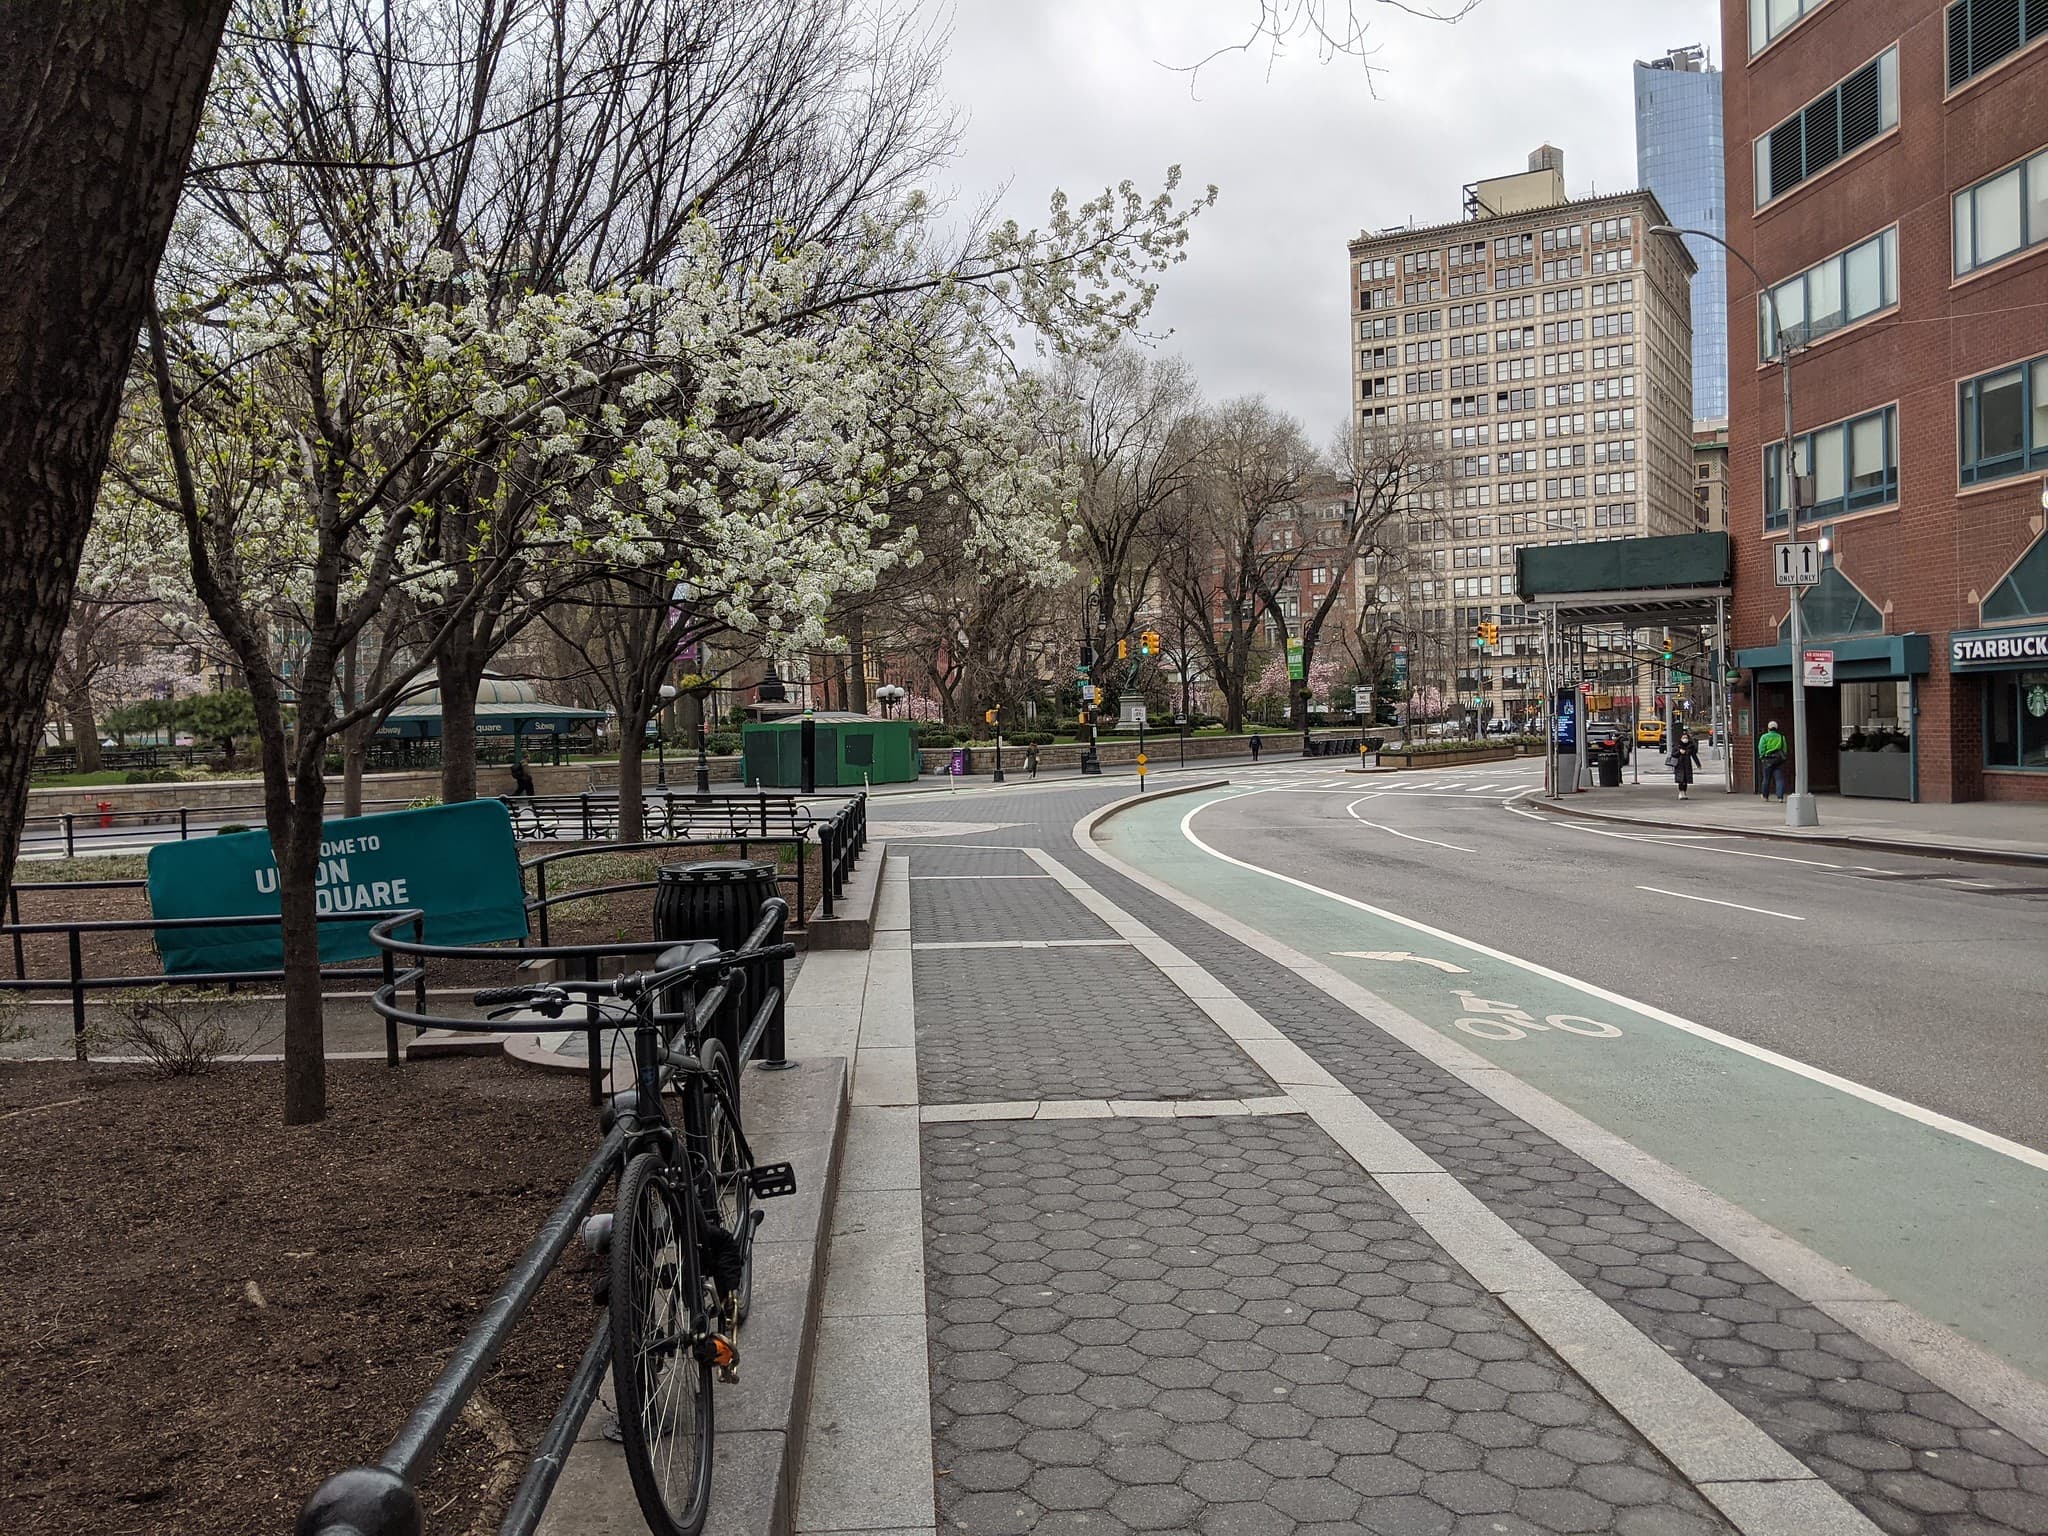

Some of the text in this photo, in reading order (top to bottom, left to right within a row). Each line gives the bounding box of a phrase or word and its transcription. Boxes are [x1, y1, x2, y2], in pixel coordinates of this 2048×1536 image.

[1779, 574, 1816, 583] ONLY ONLY
[1953, 636, 2048, 660] STARBUCK
[475, 723, 502, 732] quare
[534, 721, 556, 732] Subway
[357, 835, 380, 852] TO
[255, 858, 350, 894] UON
[316, 878, 410, 914] QUARE
